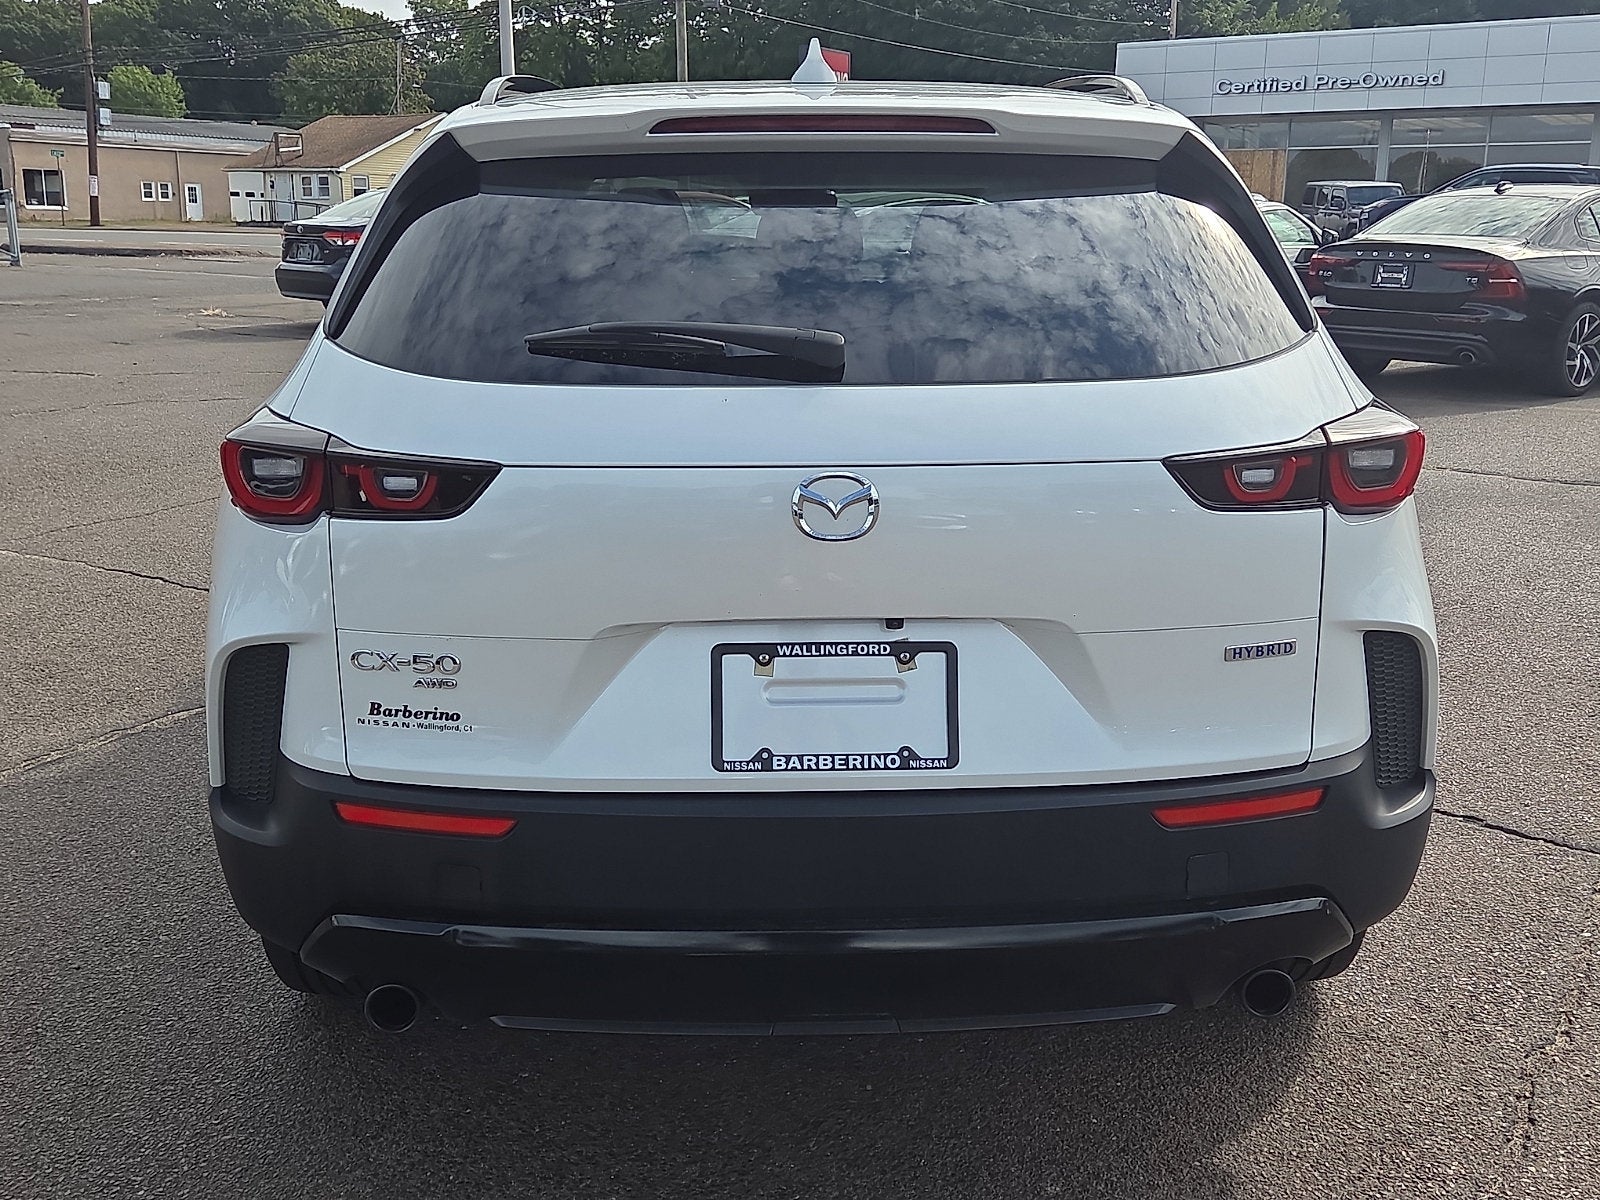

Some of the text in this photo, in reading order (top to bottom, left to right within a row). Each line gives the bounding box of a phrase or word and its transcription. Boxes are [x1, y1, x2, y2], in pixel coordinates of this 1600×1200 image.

[1215, 69, 1445, 95] Certified Pre-Owned
[1356, 250, 1431, 259] VOLVO
[776, 643, 892, 656] WALLINGFORD
[1231, 641, 1294, 660] HYBRID
[350, 648, 462, 676] CX-50
[412, 677, 458, 690] AWD
[367, 701, 462, 723] Barberino
[357, 718, 411, 729] NISSAN
[723, 754, 948, 771] NISSAN BARBERINO NISSAN
